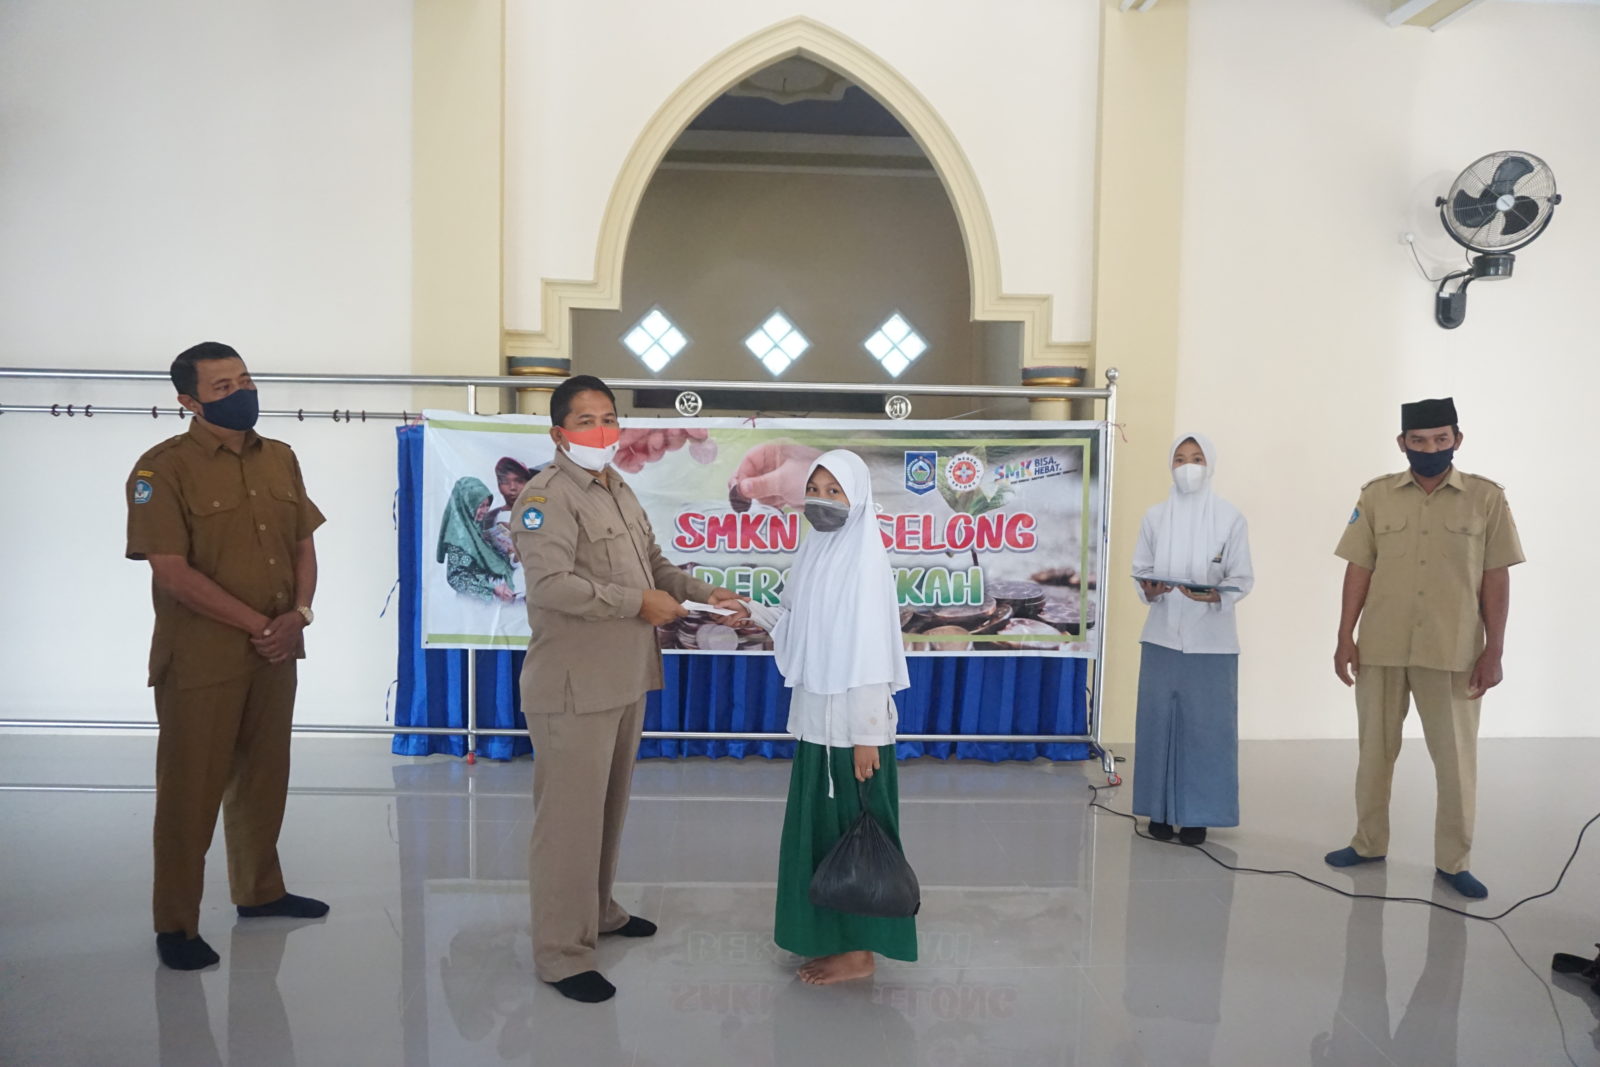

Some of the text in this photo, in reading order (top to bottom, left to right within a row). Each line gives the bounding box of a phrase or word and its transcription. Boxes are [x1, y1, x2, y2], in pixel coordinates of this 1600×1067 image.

[1034, 456, 1057, 467] BISA.
[994, 460, 1033, 480] SMK
[1034, 464, 1062, 477] HEBAT.
[674, 511, 800, 551] SMKN
